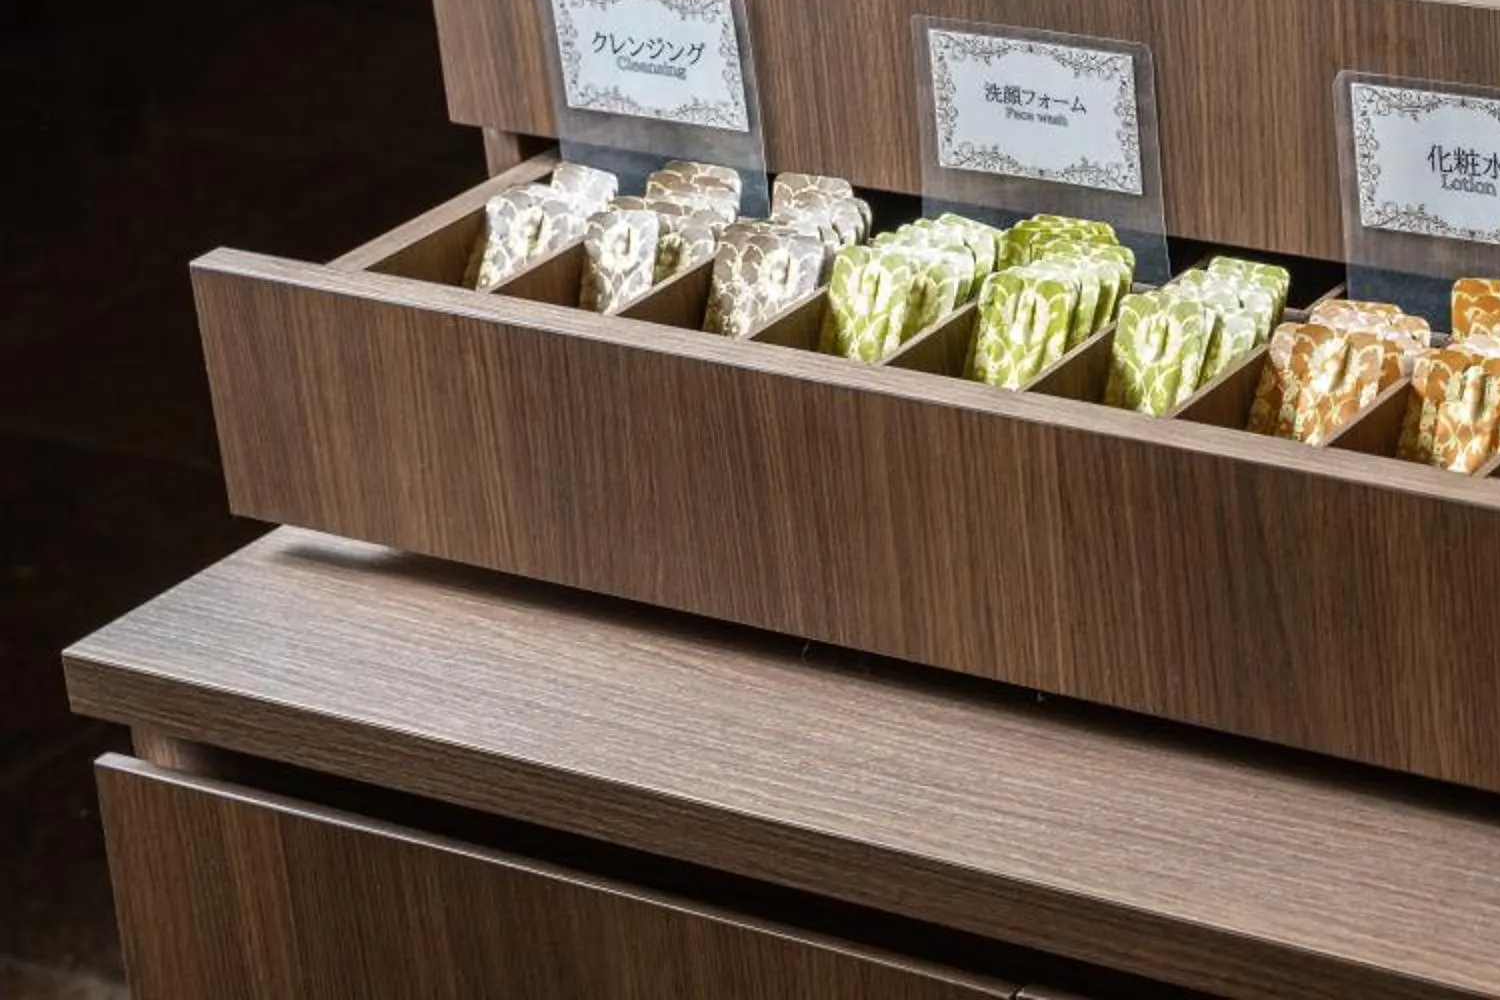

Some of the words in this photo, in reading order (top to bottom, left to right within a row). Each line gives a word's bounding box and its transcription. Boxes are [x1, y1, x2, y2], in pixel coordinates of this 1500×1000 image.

[592, 32, 705, 65] クレンジング
[985, 82, 1087, 115] 洗顔フォーム
[1441, 174, 1498, 197] Lotion
